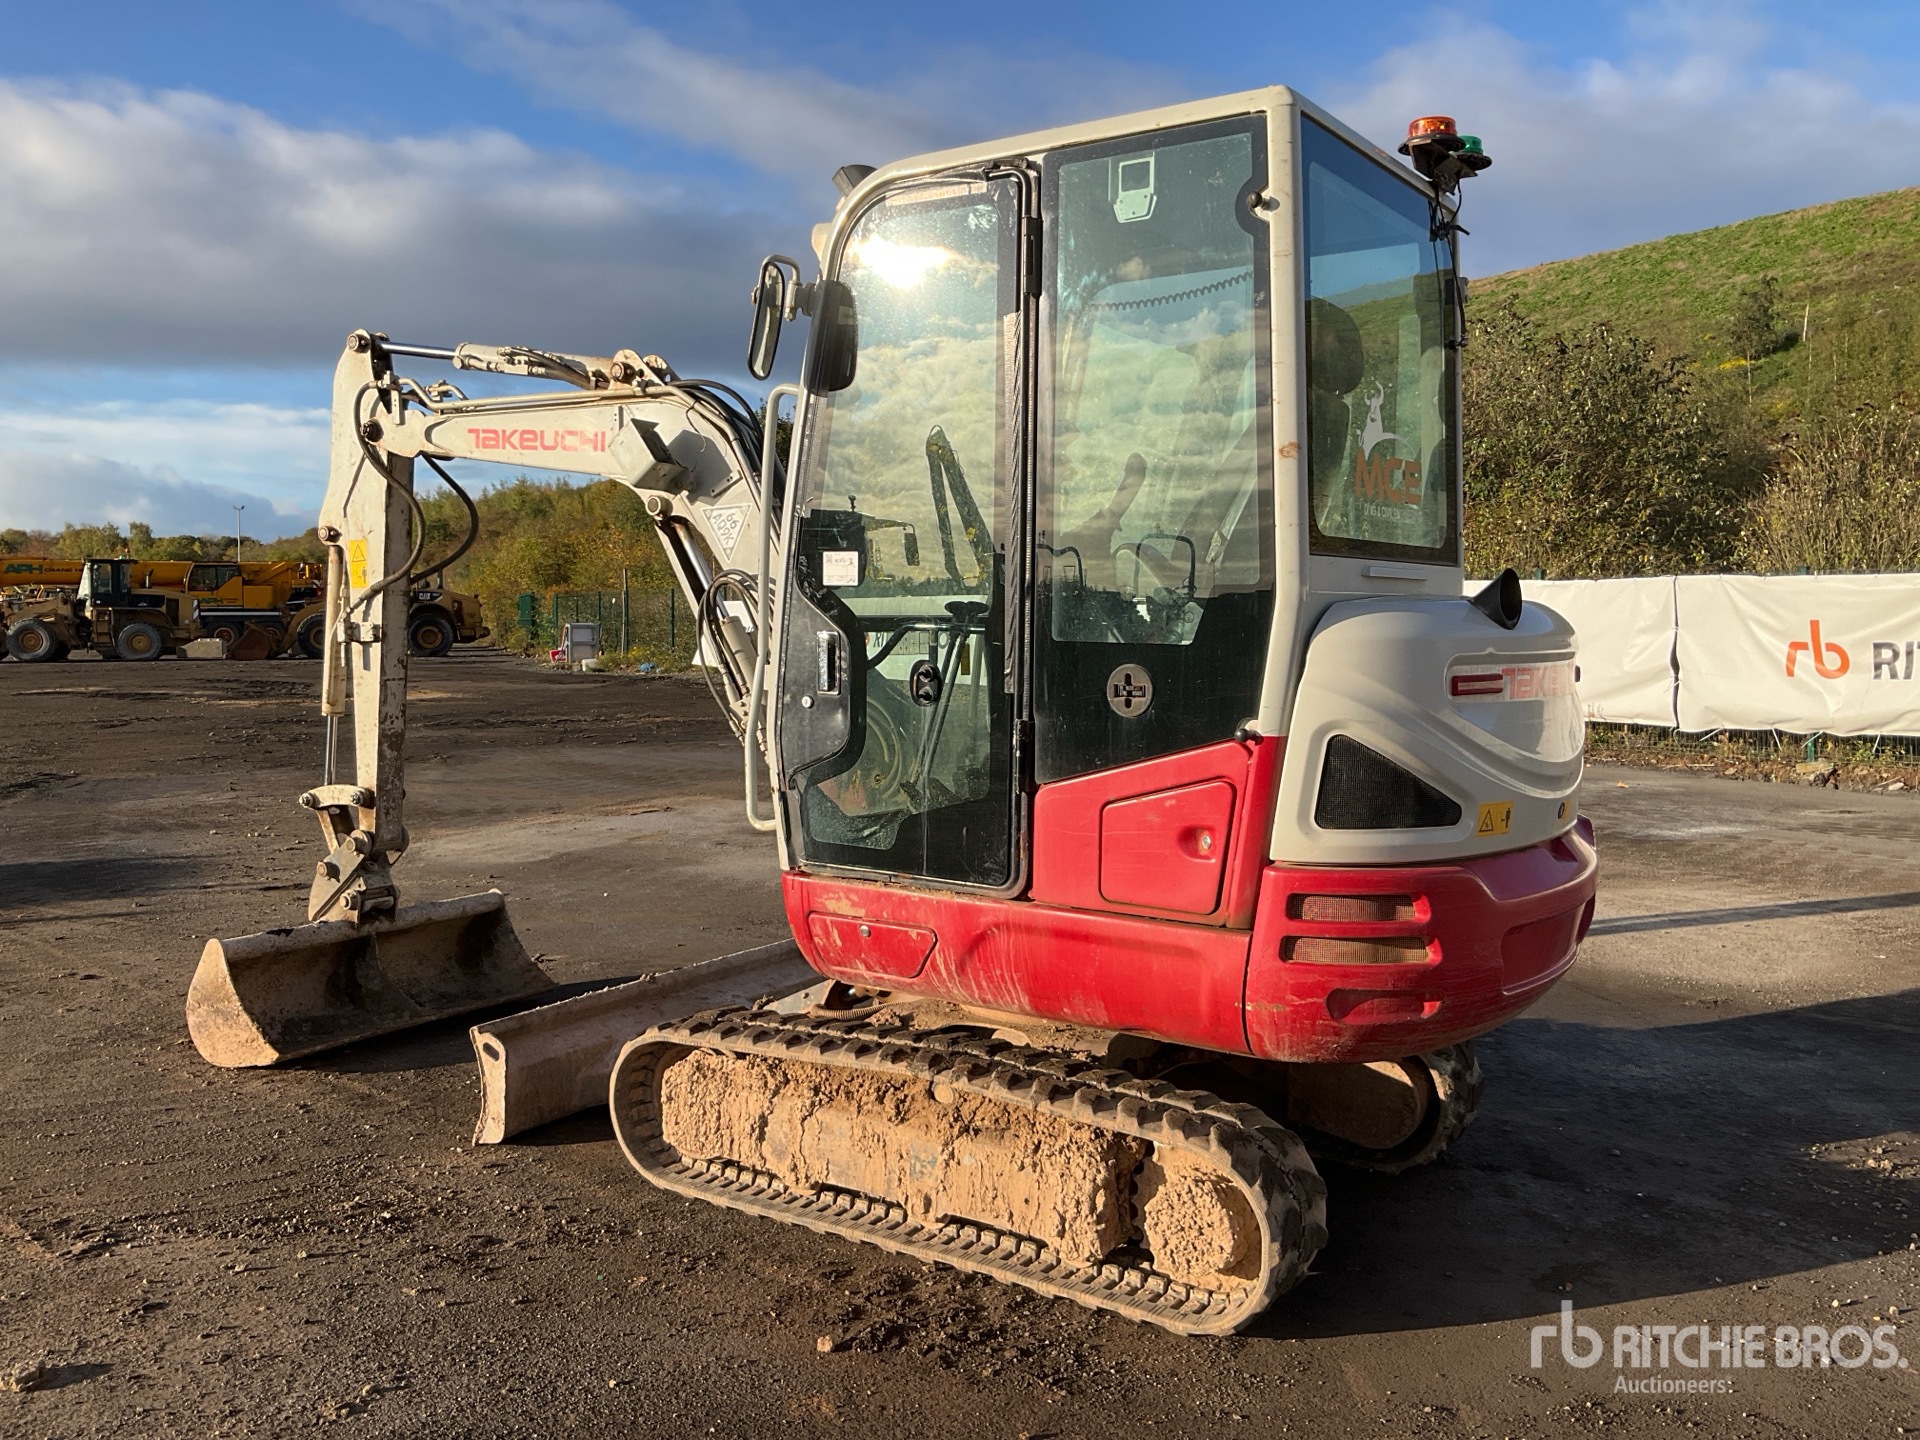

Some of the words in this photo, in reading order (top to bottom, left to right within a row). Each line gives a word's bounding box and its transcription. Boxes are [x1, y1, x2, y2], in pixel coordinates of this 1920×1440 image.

[1355, 447, 1422, 505] MCE
[726, 512, 740, 529] 66
[3, 563, 43, 574] APH
[418, 592, 431, 600] CAT
